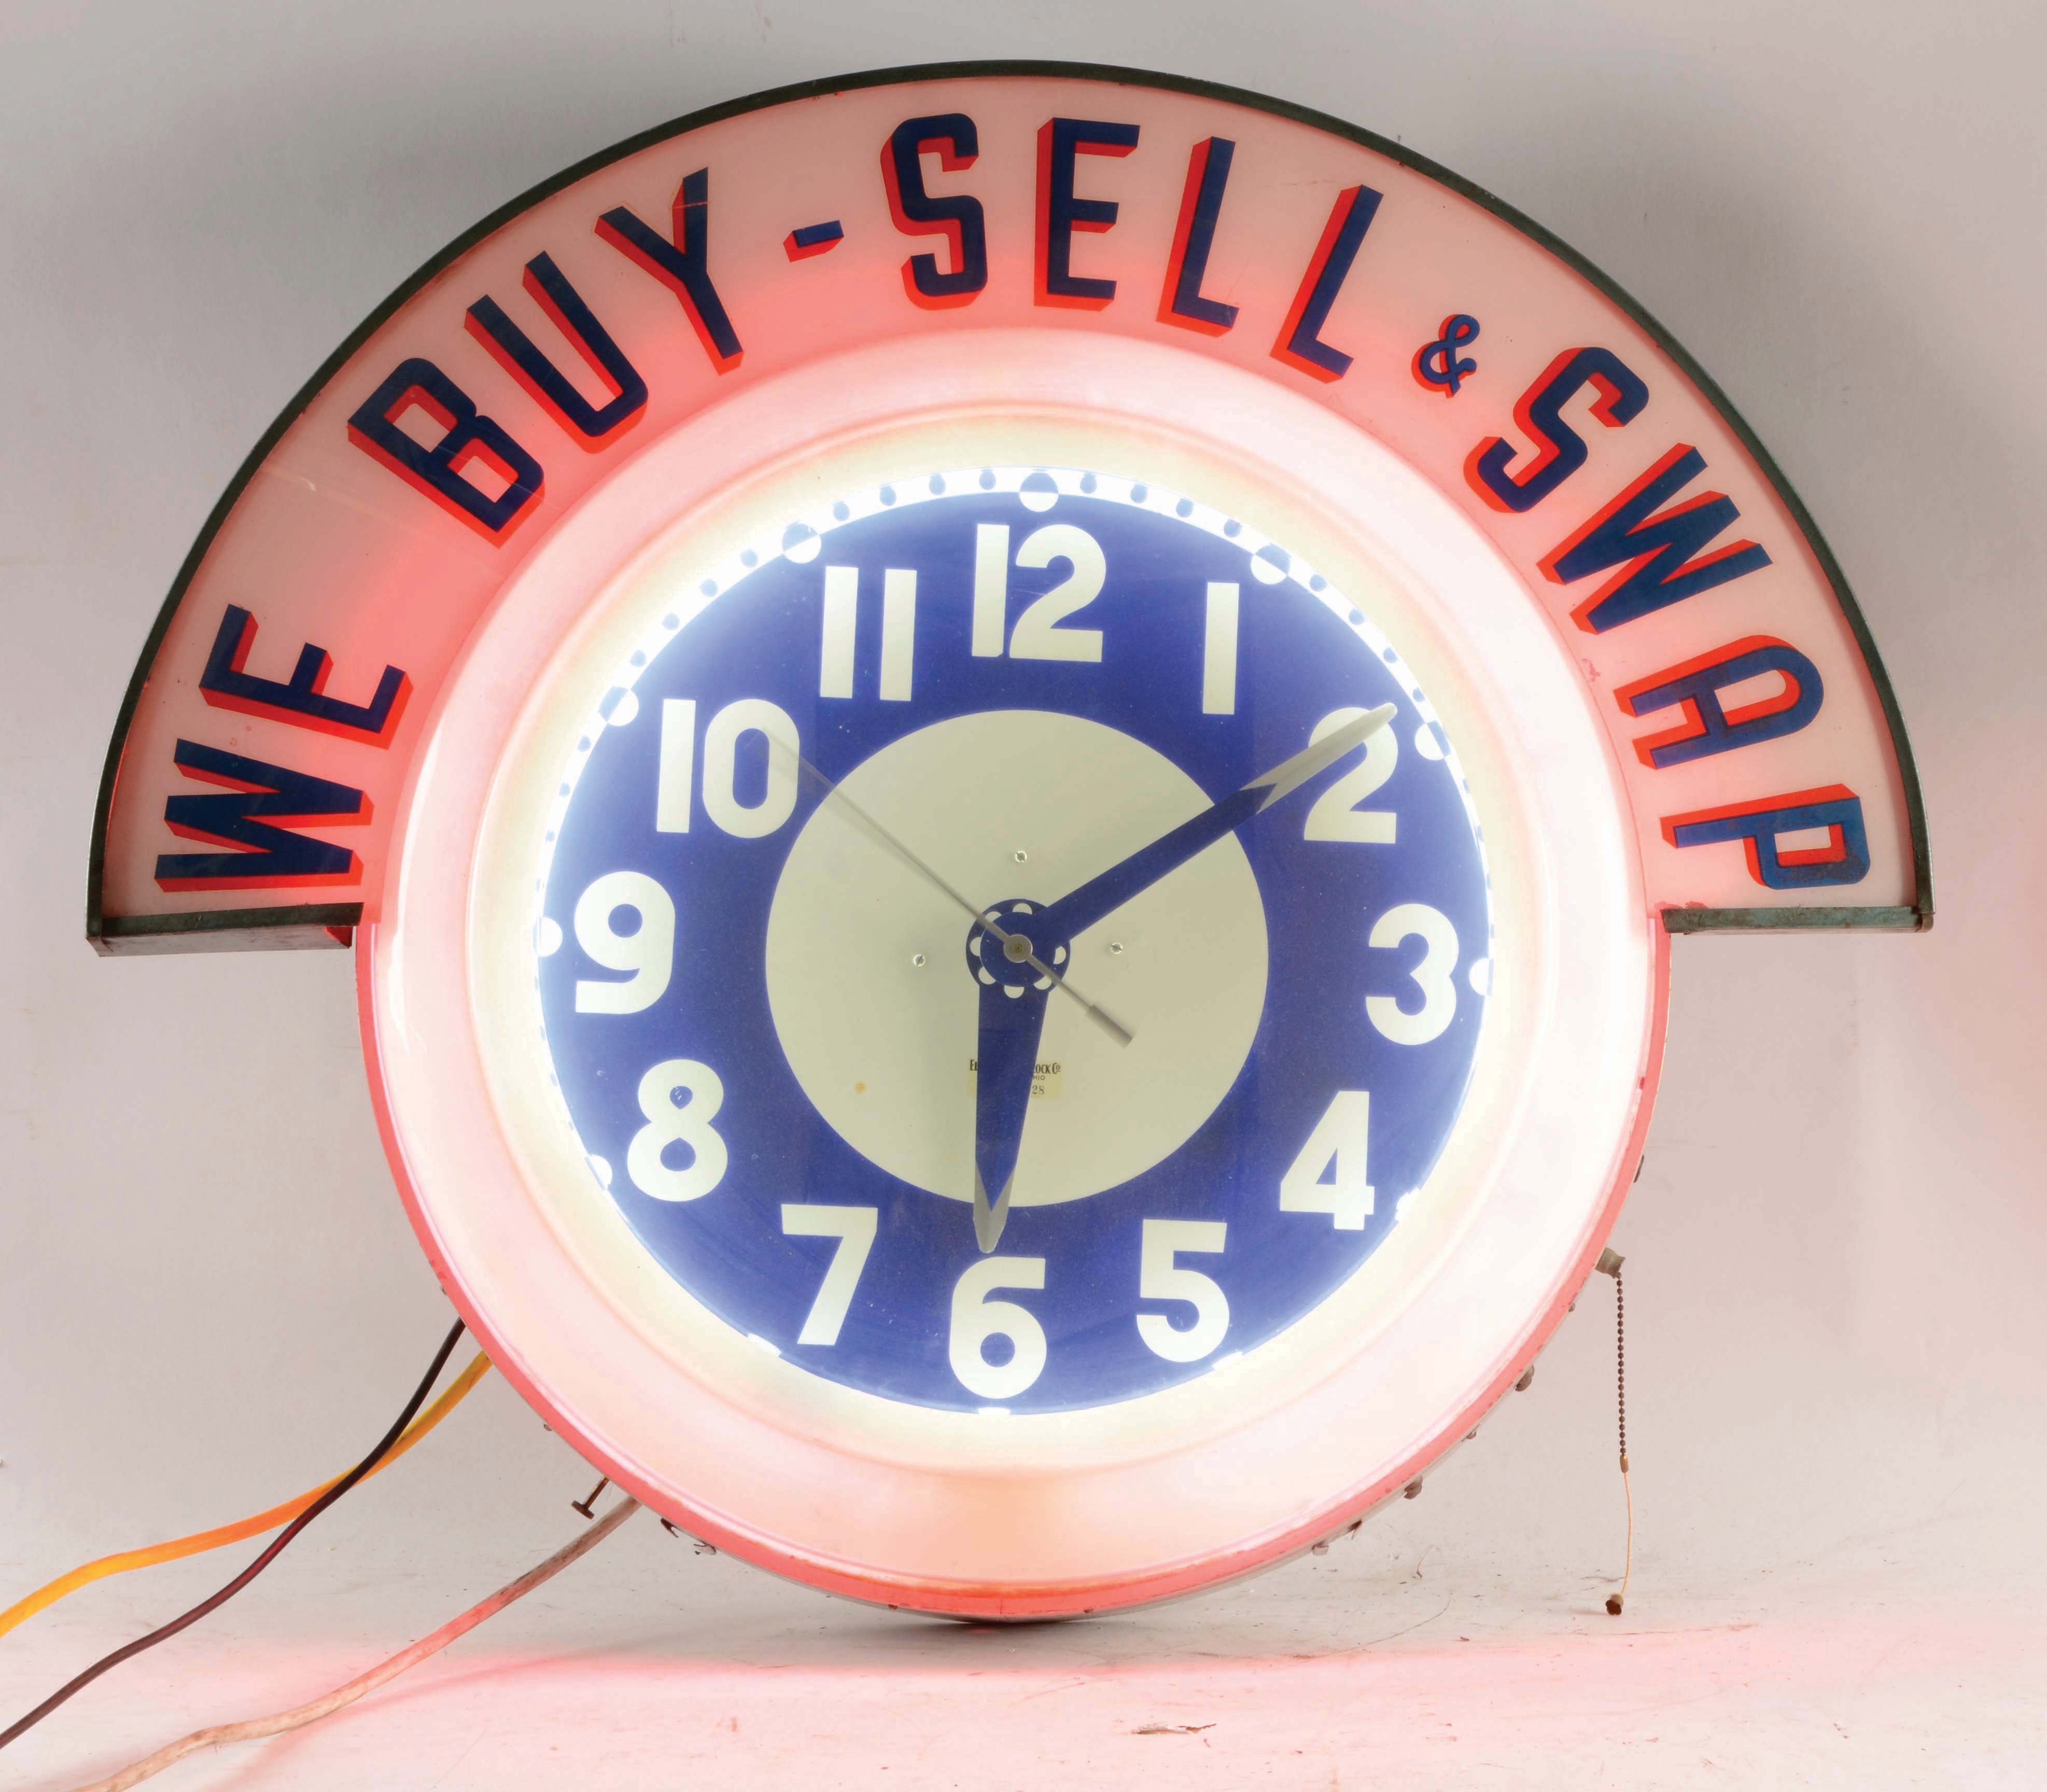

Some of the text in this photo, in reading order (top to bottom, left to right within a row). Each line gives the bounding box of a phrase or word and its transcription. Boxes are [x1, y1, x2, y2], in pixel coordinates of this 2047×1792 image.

[153, 603, 414, 893] WE
[1411, 314, 1480, 398] &
[1464, 347, 1871, 890] SWAP
[820, 565, 917, 702] 11
[972, 523, 1106, 663] 12
[1202, 582, 1240, 715] 1
[656, 698, 800, 838] 10
[1303, 707, 1399, 844] 2
[574, 871, 676, 1014] 9
[1366, 903, 1459, 1045] 3
[627, 1059, 728, 1202] 8
[1034, 1063, 1050, 1074] OCK
[1279, 1090, 1375, 1231] 4
[781, 1203, 878, 1346] 7
[949, 1256, 1047, 1399] 6
[1136, 1219, 1230, 1363] 5
